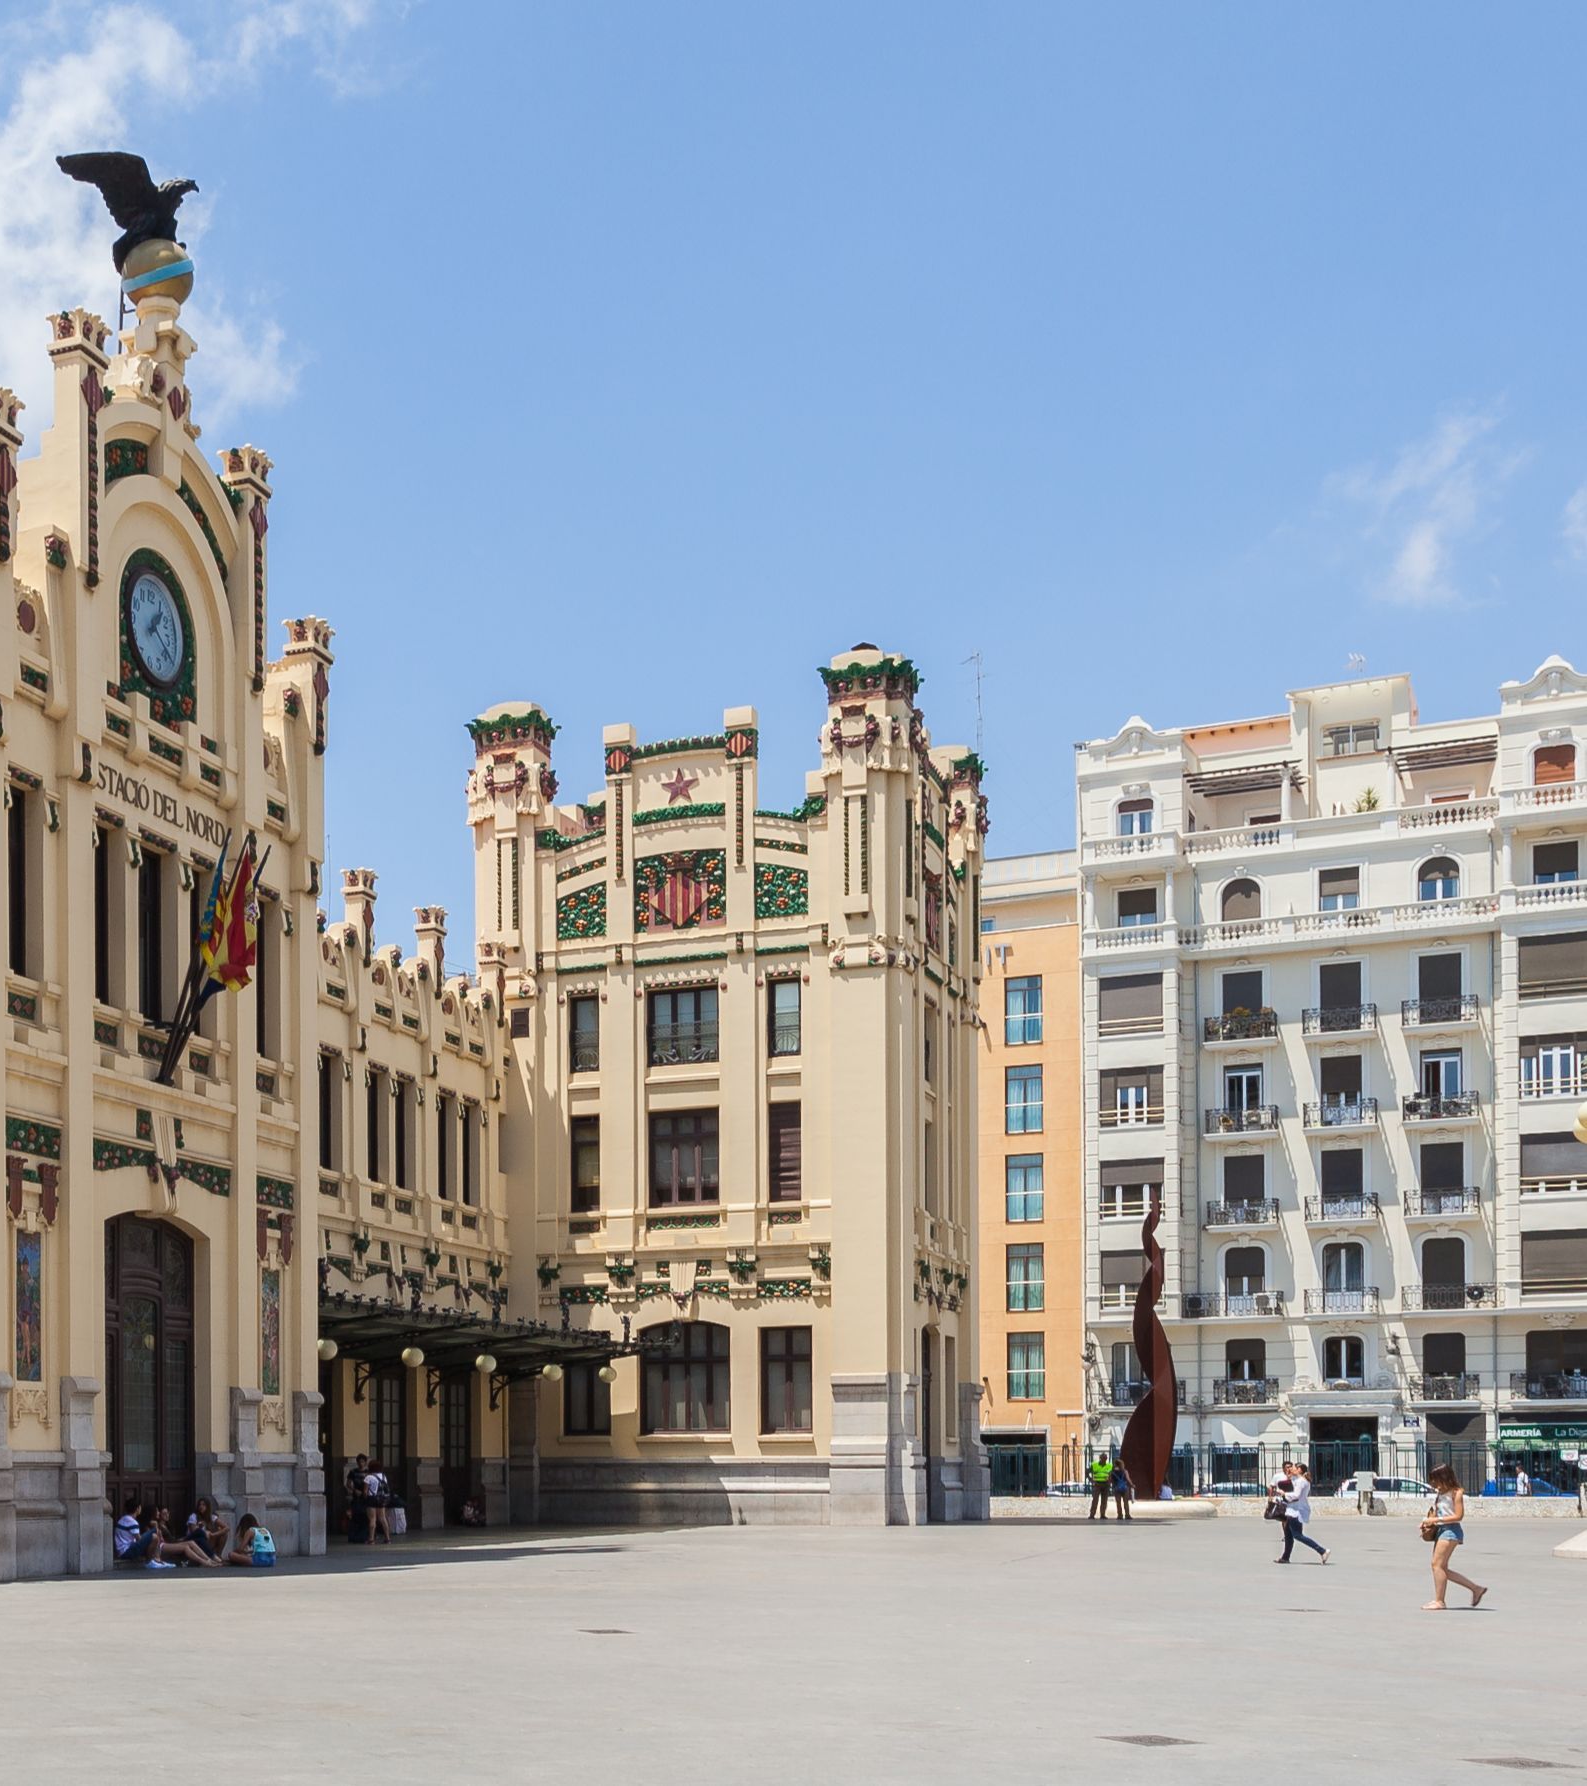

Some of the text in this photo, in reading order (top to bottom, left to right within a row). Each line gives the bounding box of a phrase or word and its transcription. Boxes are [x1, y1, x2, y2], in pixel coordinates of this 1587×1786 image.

[147, 589, 156, 604] 12
[96, 762, 226, 848] STACIÓ DEL NORD
[1500, 1426, 1542, 1437] ARMERÍA
[1554, 1427, 1567, 1437] La
